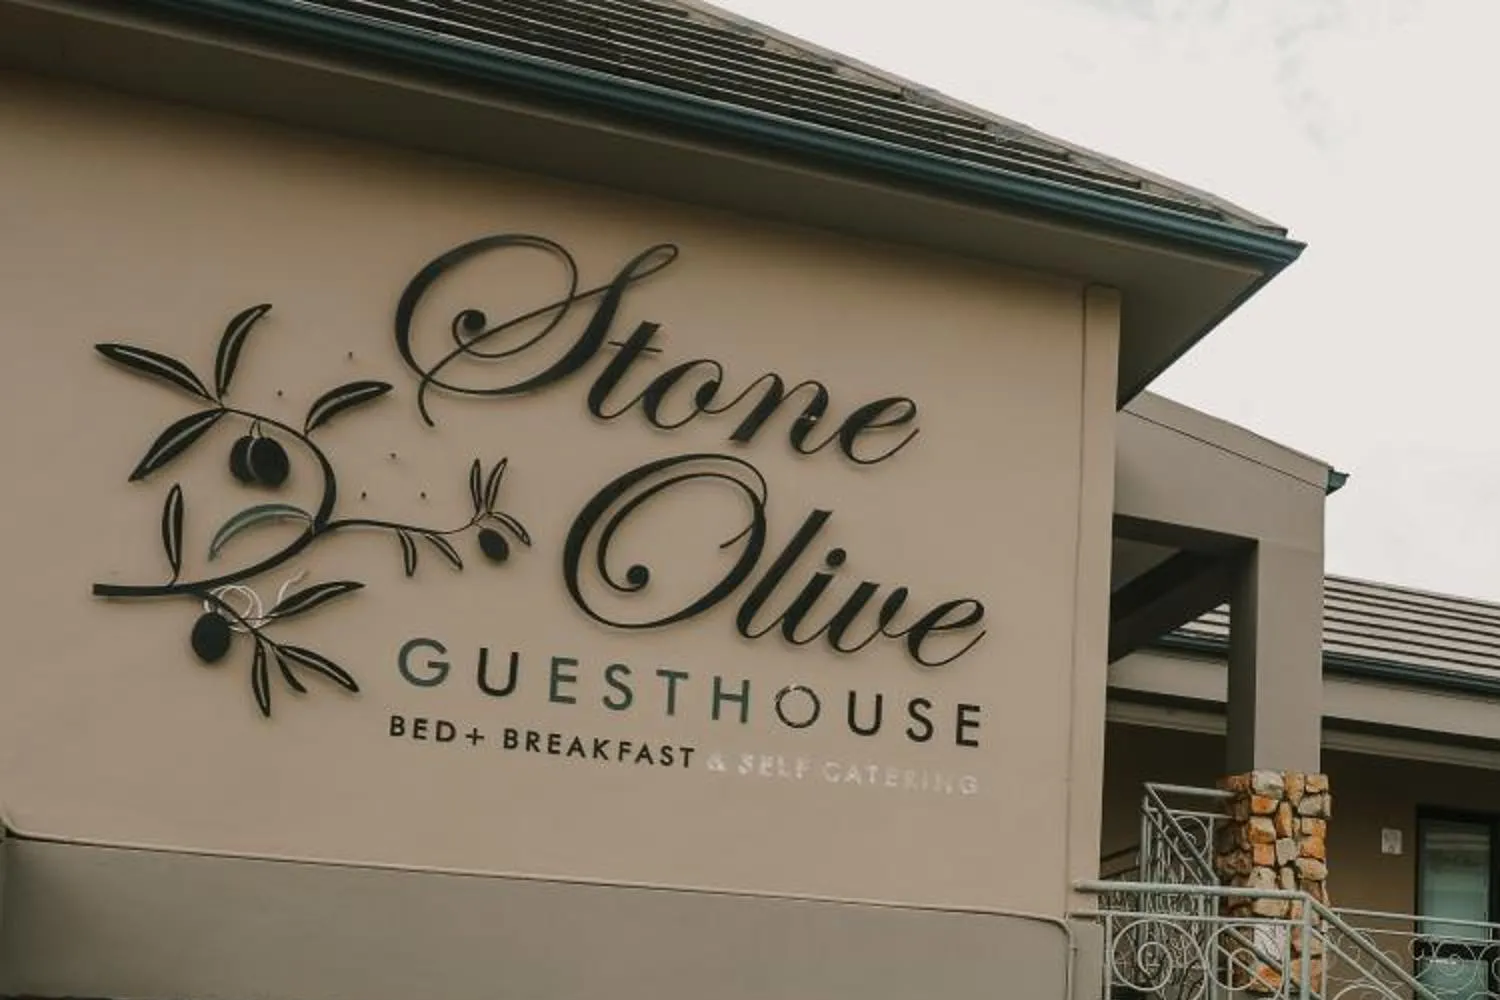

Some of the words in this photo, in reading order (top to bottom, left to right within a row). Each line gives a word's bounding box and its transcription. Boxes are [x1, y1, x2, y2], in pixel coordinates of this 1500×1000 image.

[394, 234, 919, 465] Stone
[562, 453, 986, 667] Olive
[397, 637, 983, 749] GUESTHOUSE
[503, 728, 695, 768] BREAKFAST
[738, 754, 810, 779] SELF
